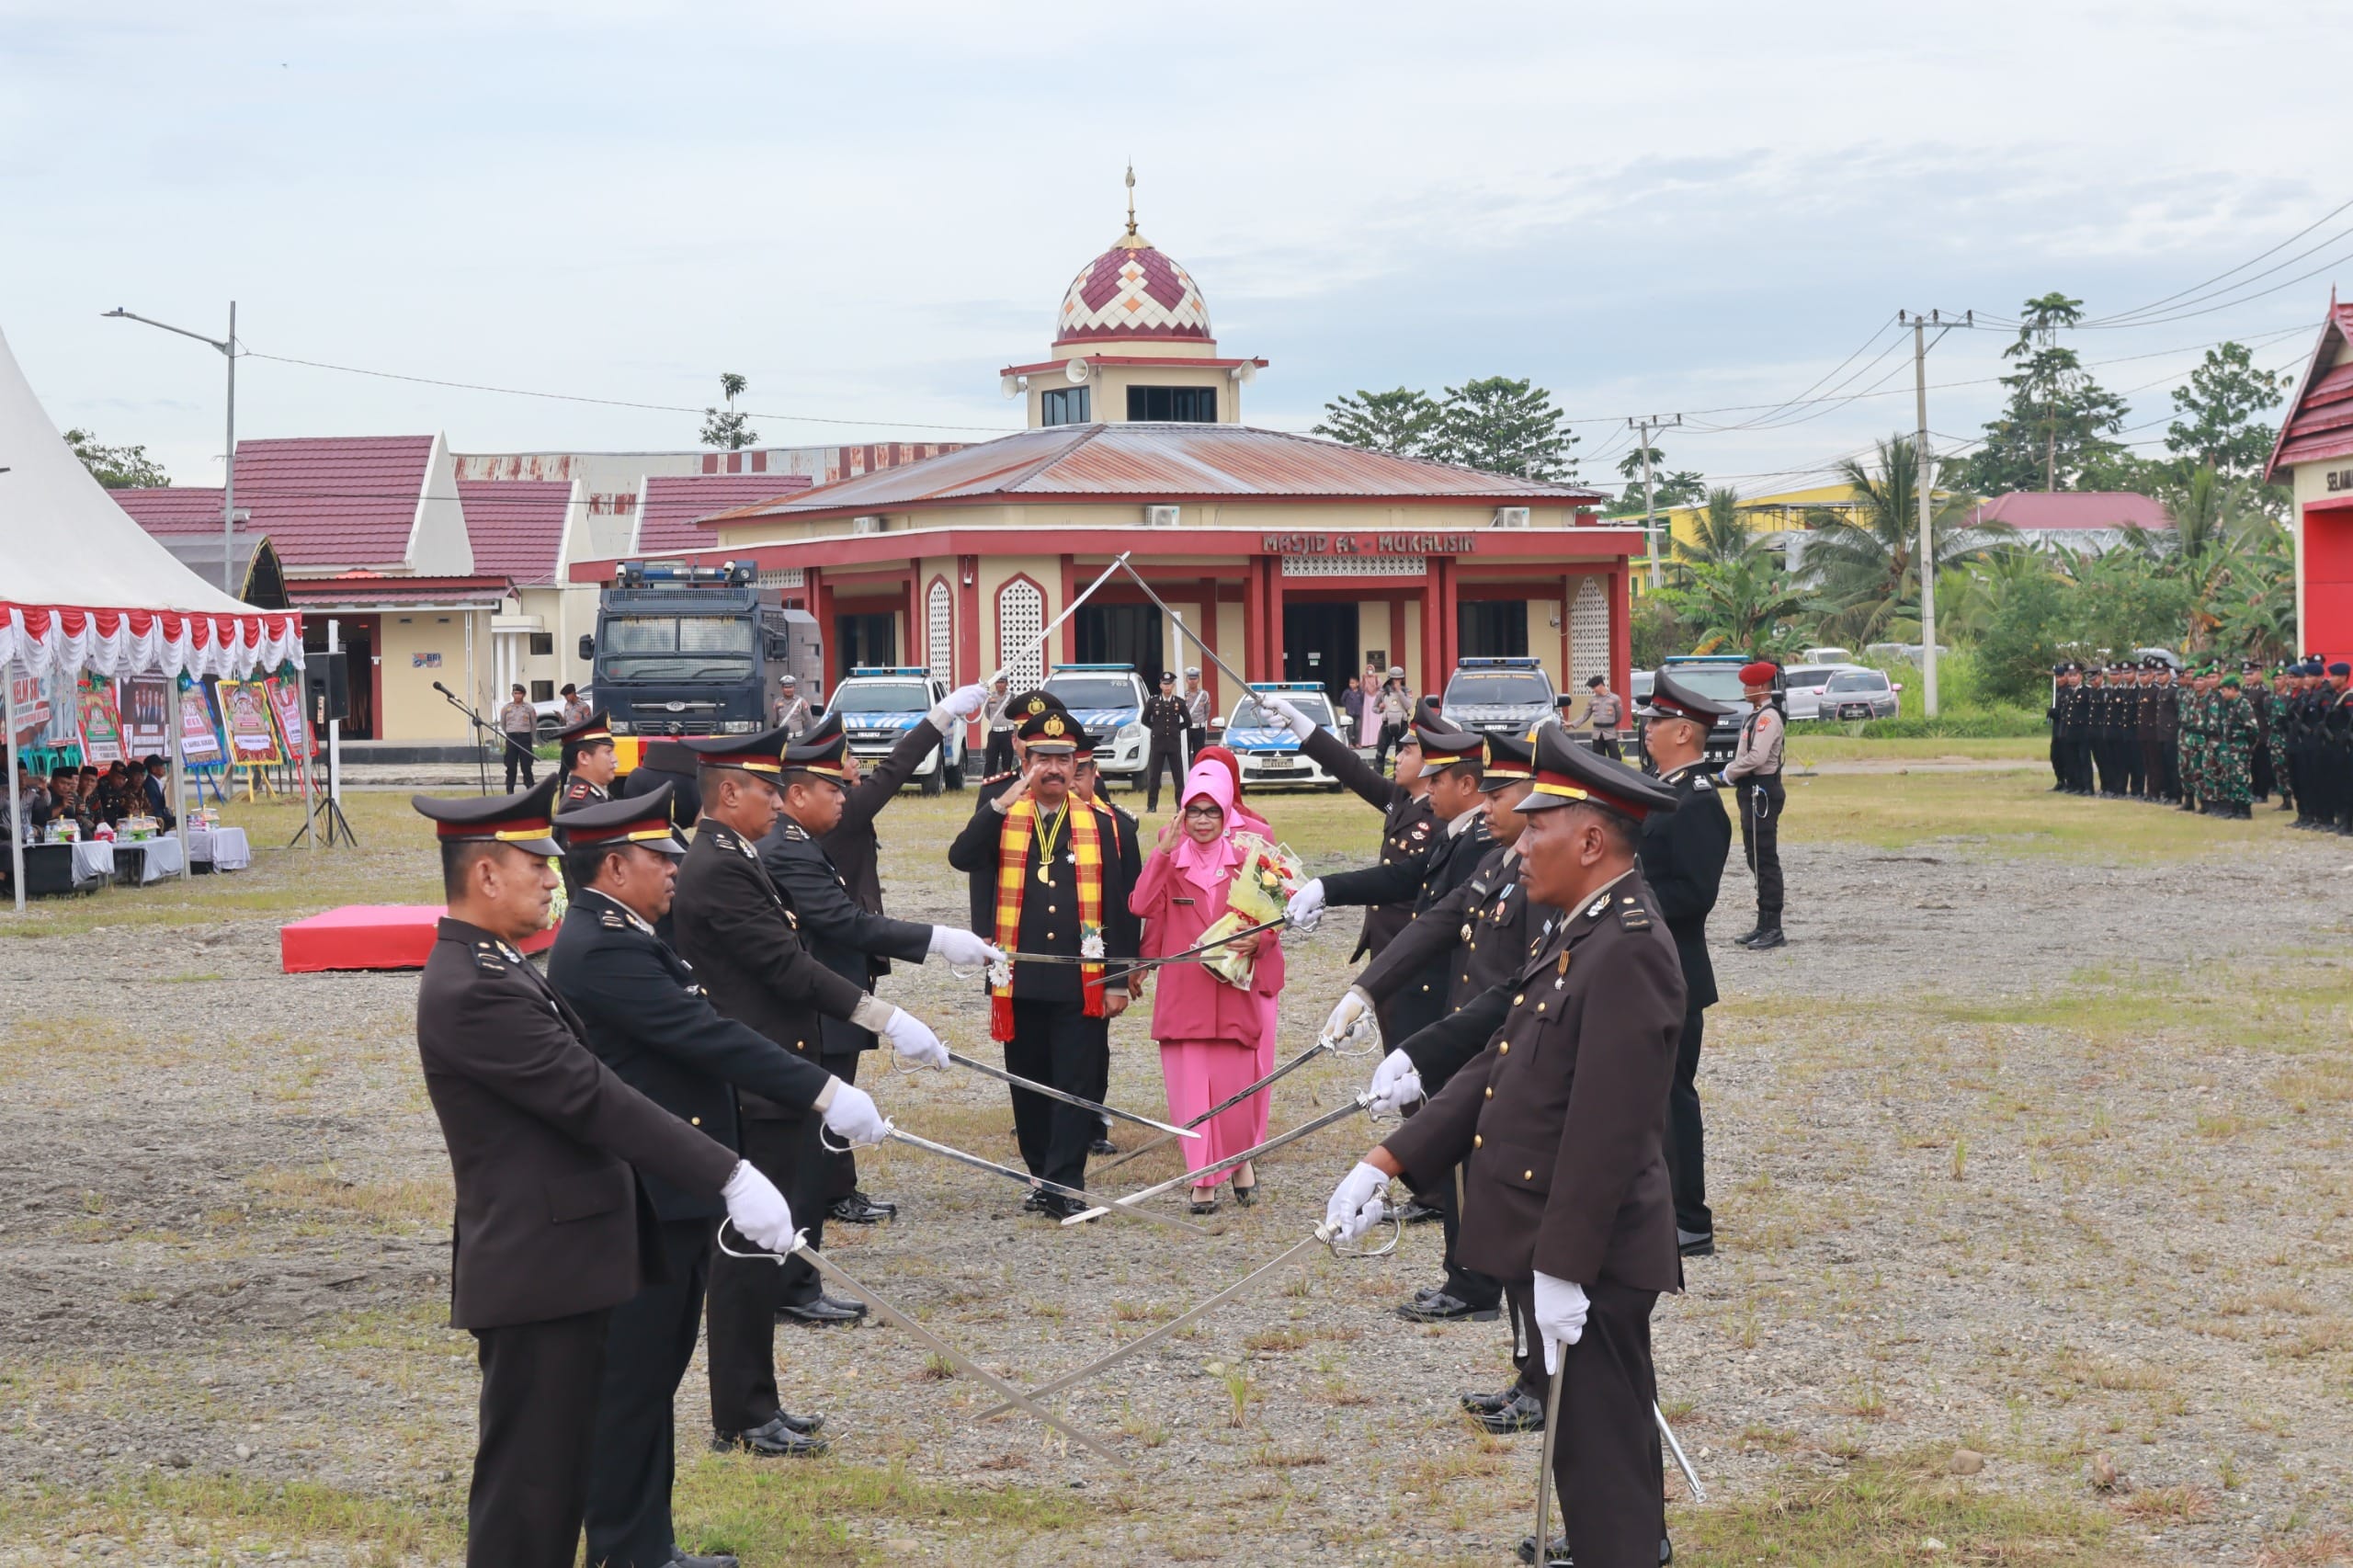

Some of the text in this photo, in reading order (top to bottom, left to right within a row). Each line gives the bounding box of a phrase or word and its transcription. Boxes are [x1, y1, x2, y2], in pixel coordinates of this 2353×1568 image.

[1262, 534, 1329, 555] MASJID
[1336, 535, 1359, 554] AL
[1378, 534, 1476, 553] MUKHLISIN
